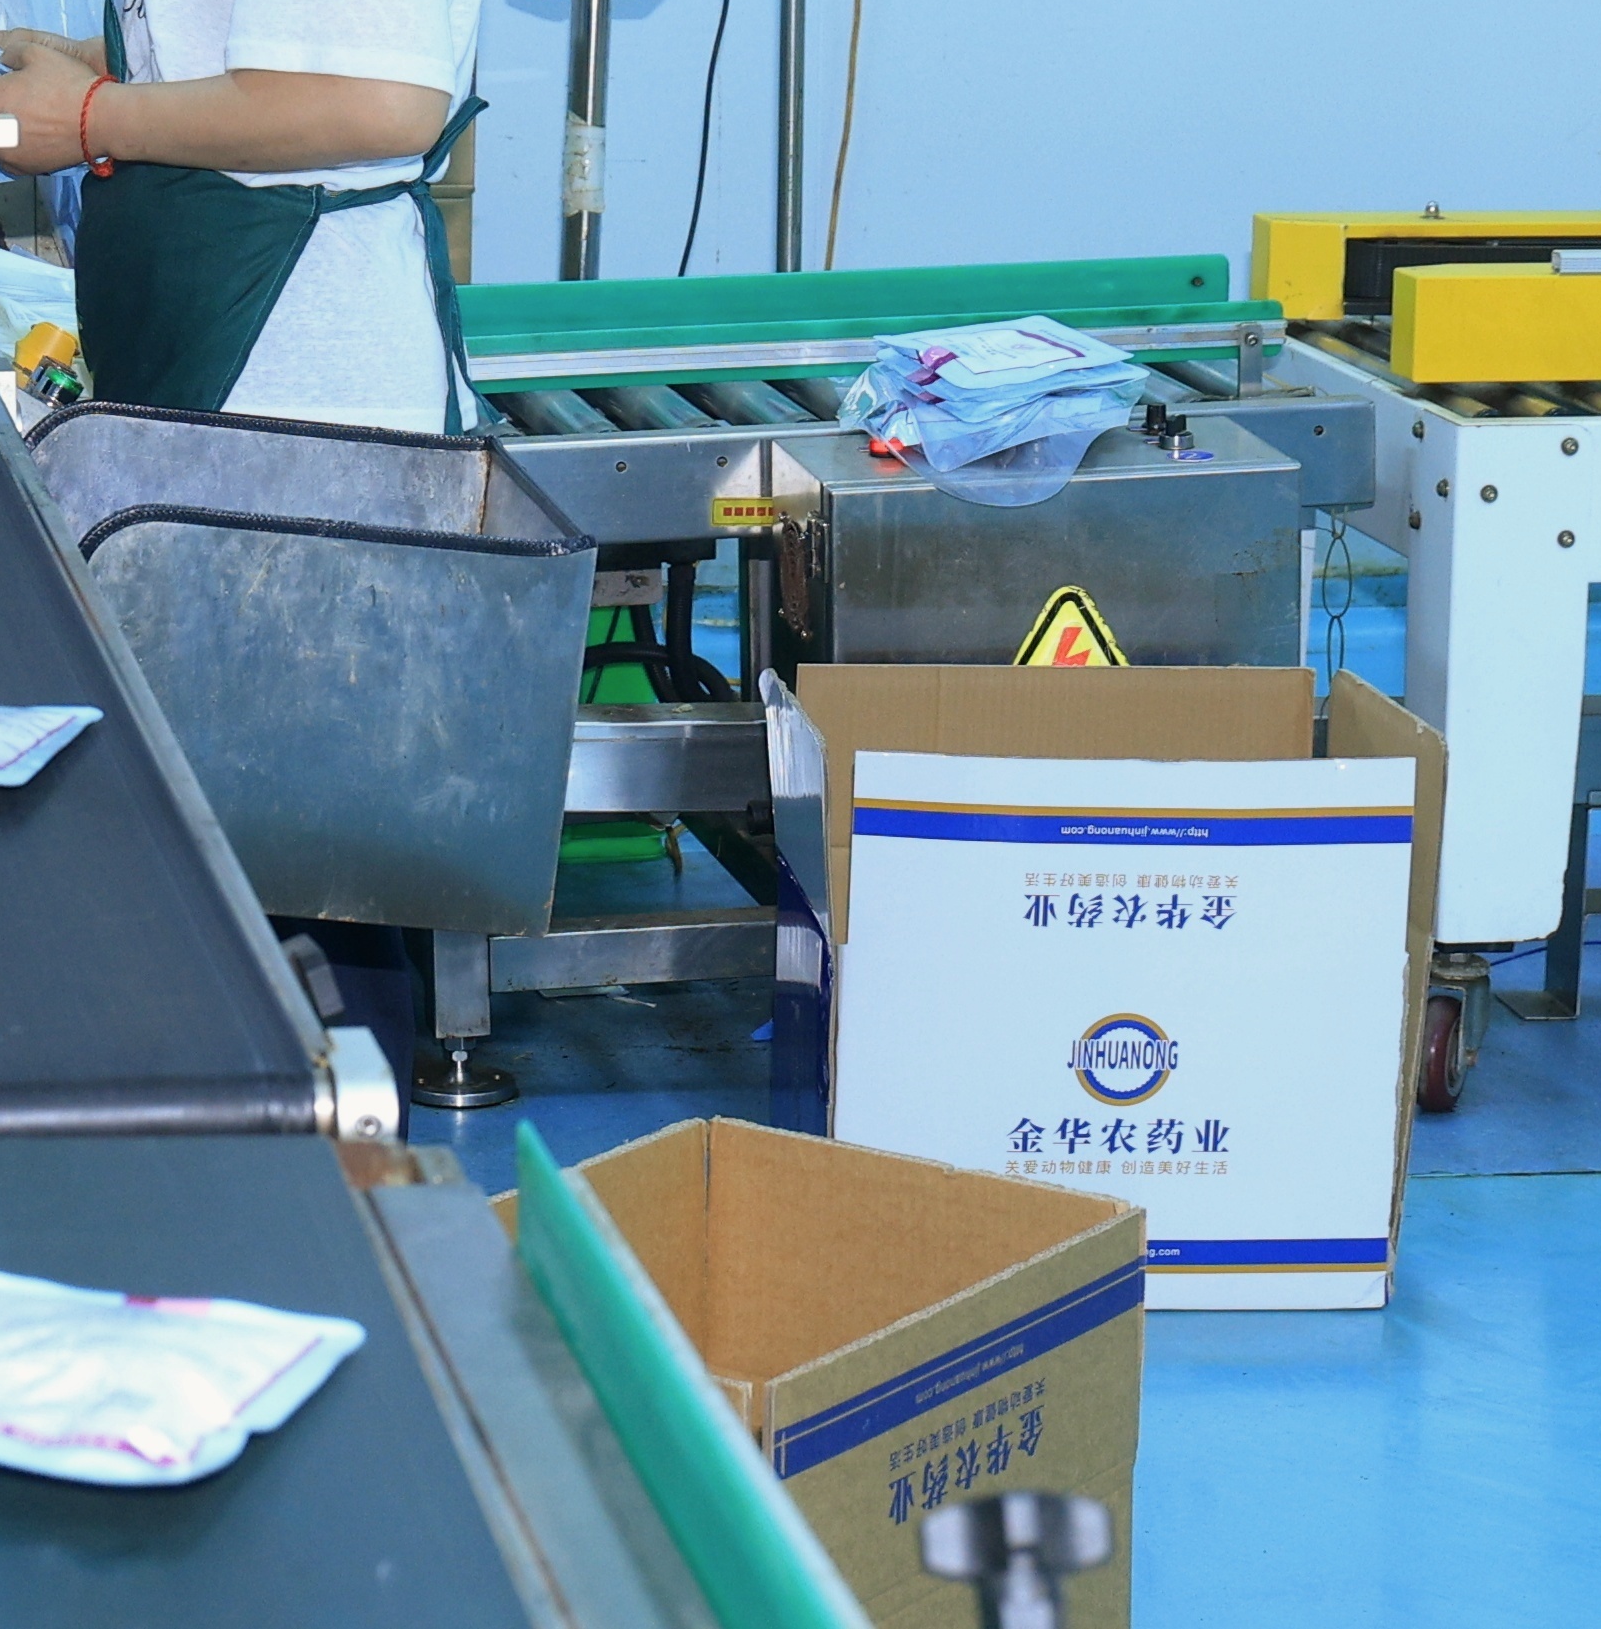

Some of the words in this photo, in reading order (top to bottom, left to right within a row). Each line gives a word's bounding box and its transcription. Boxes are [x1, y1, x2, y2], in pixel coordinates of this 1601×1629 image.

[1060, 824, 1209, 838] http://www.jinhuanong.com
[1023, 892, 1238, 930] 金华农药业
[1066, 1039, 1179, 1070] JINHUANONG
[1006, 1117, 1231, 1155] 金华农药业
[1004, 1160, 1112, 1175] 关爱动物健康
[1121, 1159, 1229, 1175] 创造美好生活
[888, 1404, 1046, 1526] 金华农药业
